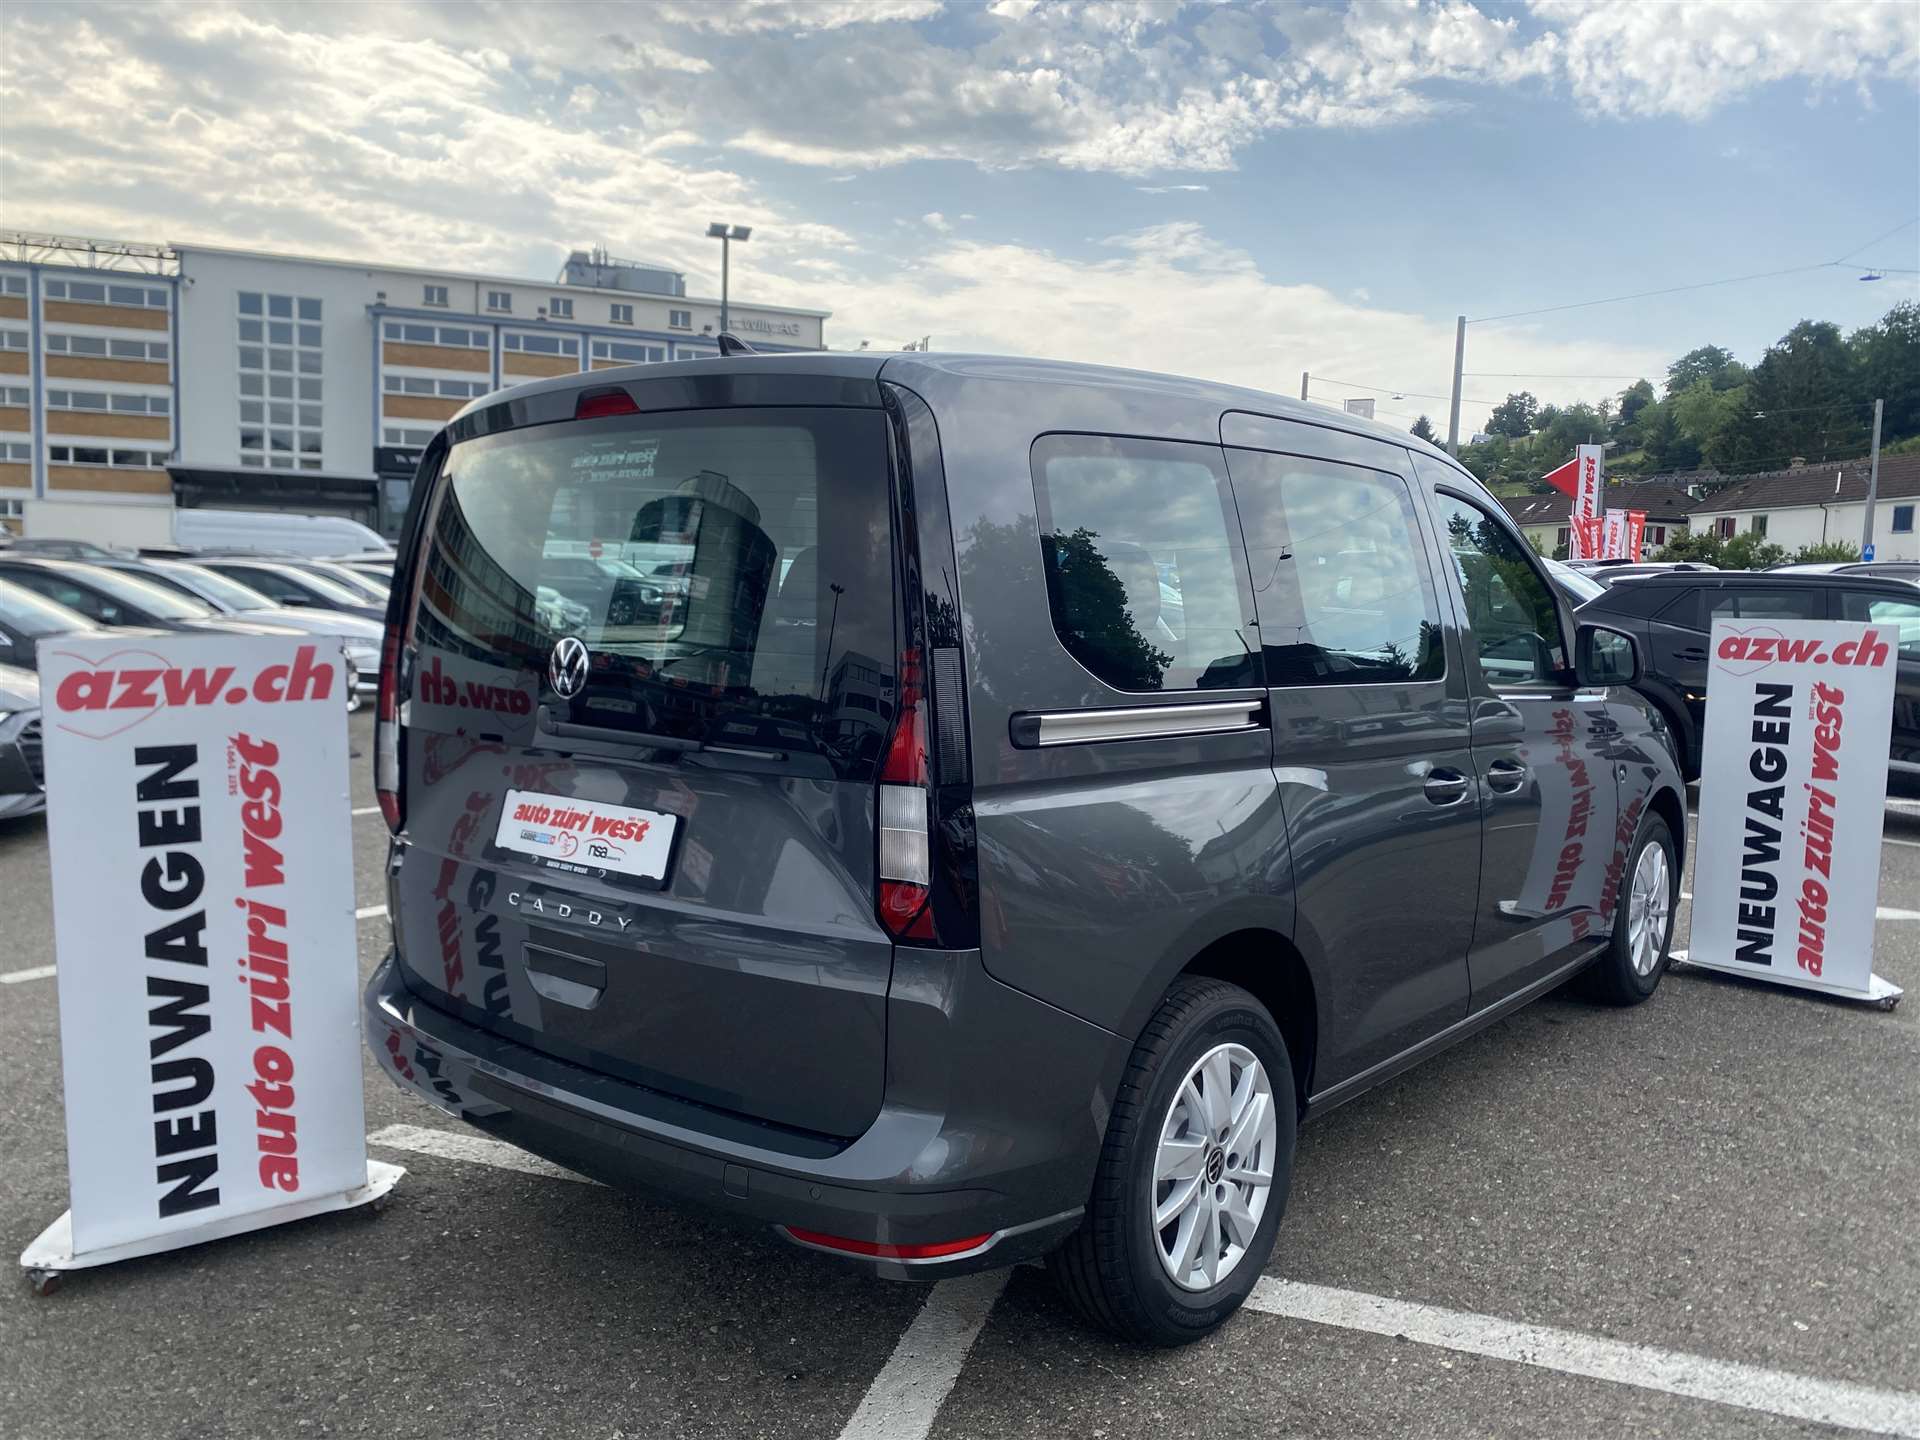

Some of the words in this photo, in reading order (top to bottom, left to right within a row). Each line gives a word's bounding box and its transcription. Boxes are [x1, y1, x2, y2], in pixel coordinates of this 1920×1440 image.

[1585, 456, 1596, 494] west
[56, 645, 335, 713] azw.ch
[1717, 629, 1890, 668] azw.ch
[1811, 680, 1846, 782] west
[227, 774, 237, 796] SEIT
[228, 732, 284, 889] west
[514, 804, 550, 824] auto
[549, 806, 594, 832] züri
[591, 816, 650, 842] west
[1735, 682, 1793, 967] NEUWAGEN
[1799, 782, 1837, 881] züri
[588, 845, 607, 858] nsa
[508, 892, 632, 931] CADDY
[1796, 877, 1829, 978] auto
[134, 743, 220, 1219] NEUWAGEN
[235, 897, 294, 1040] züri
[243, 1043, 301, 1193] auto
